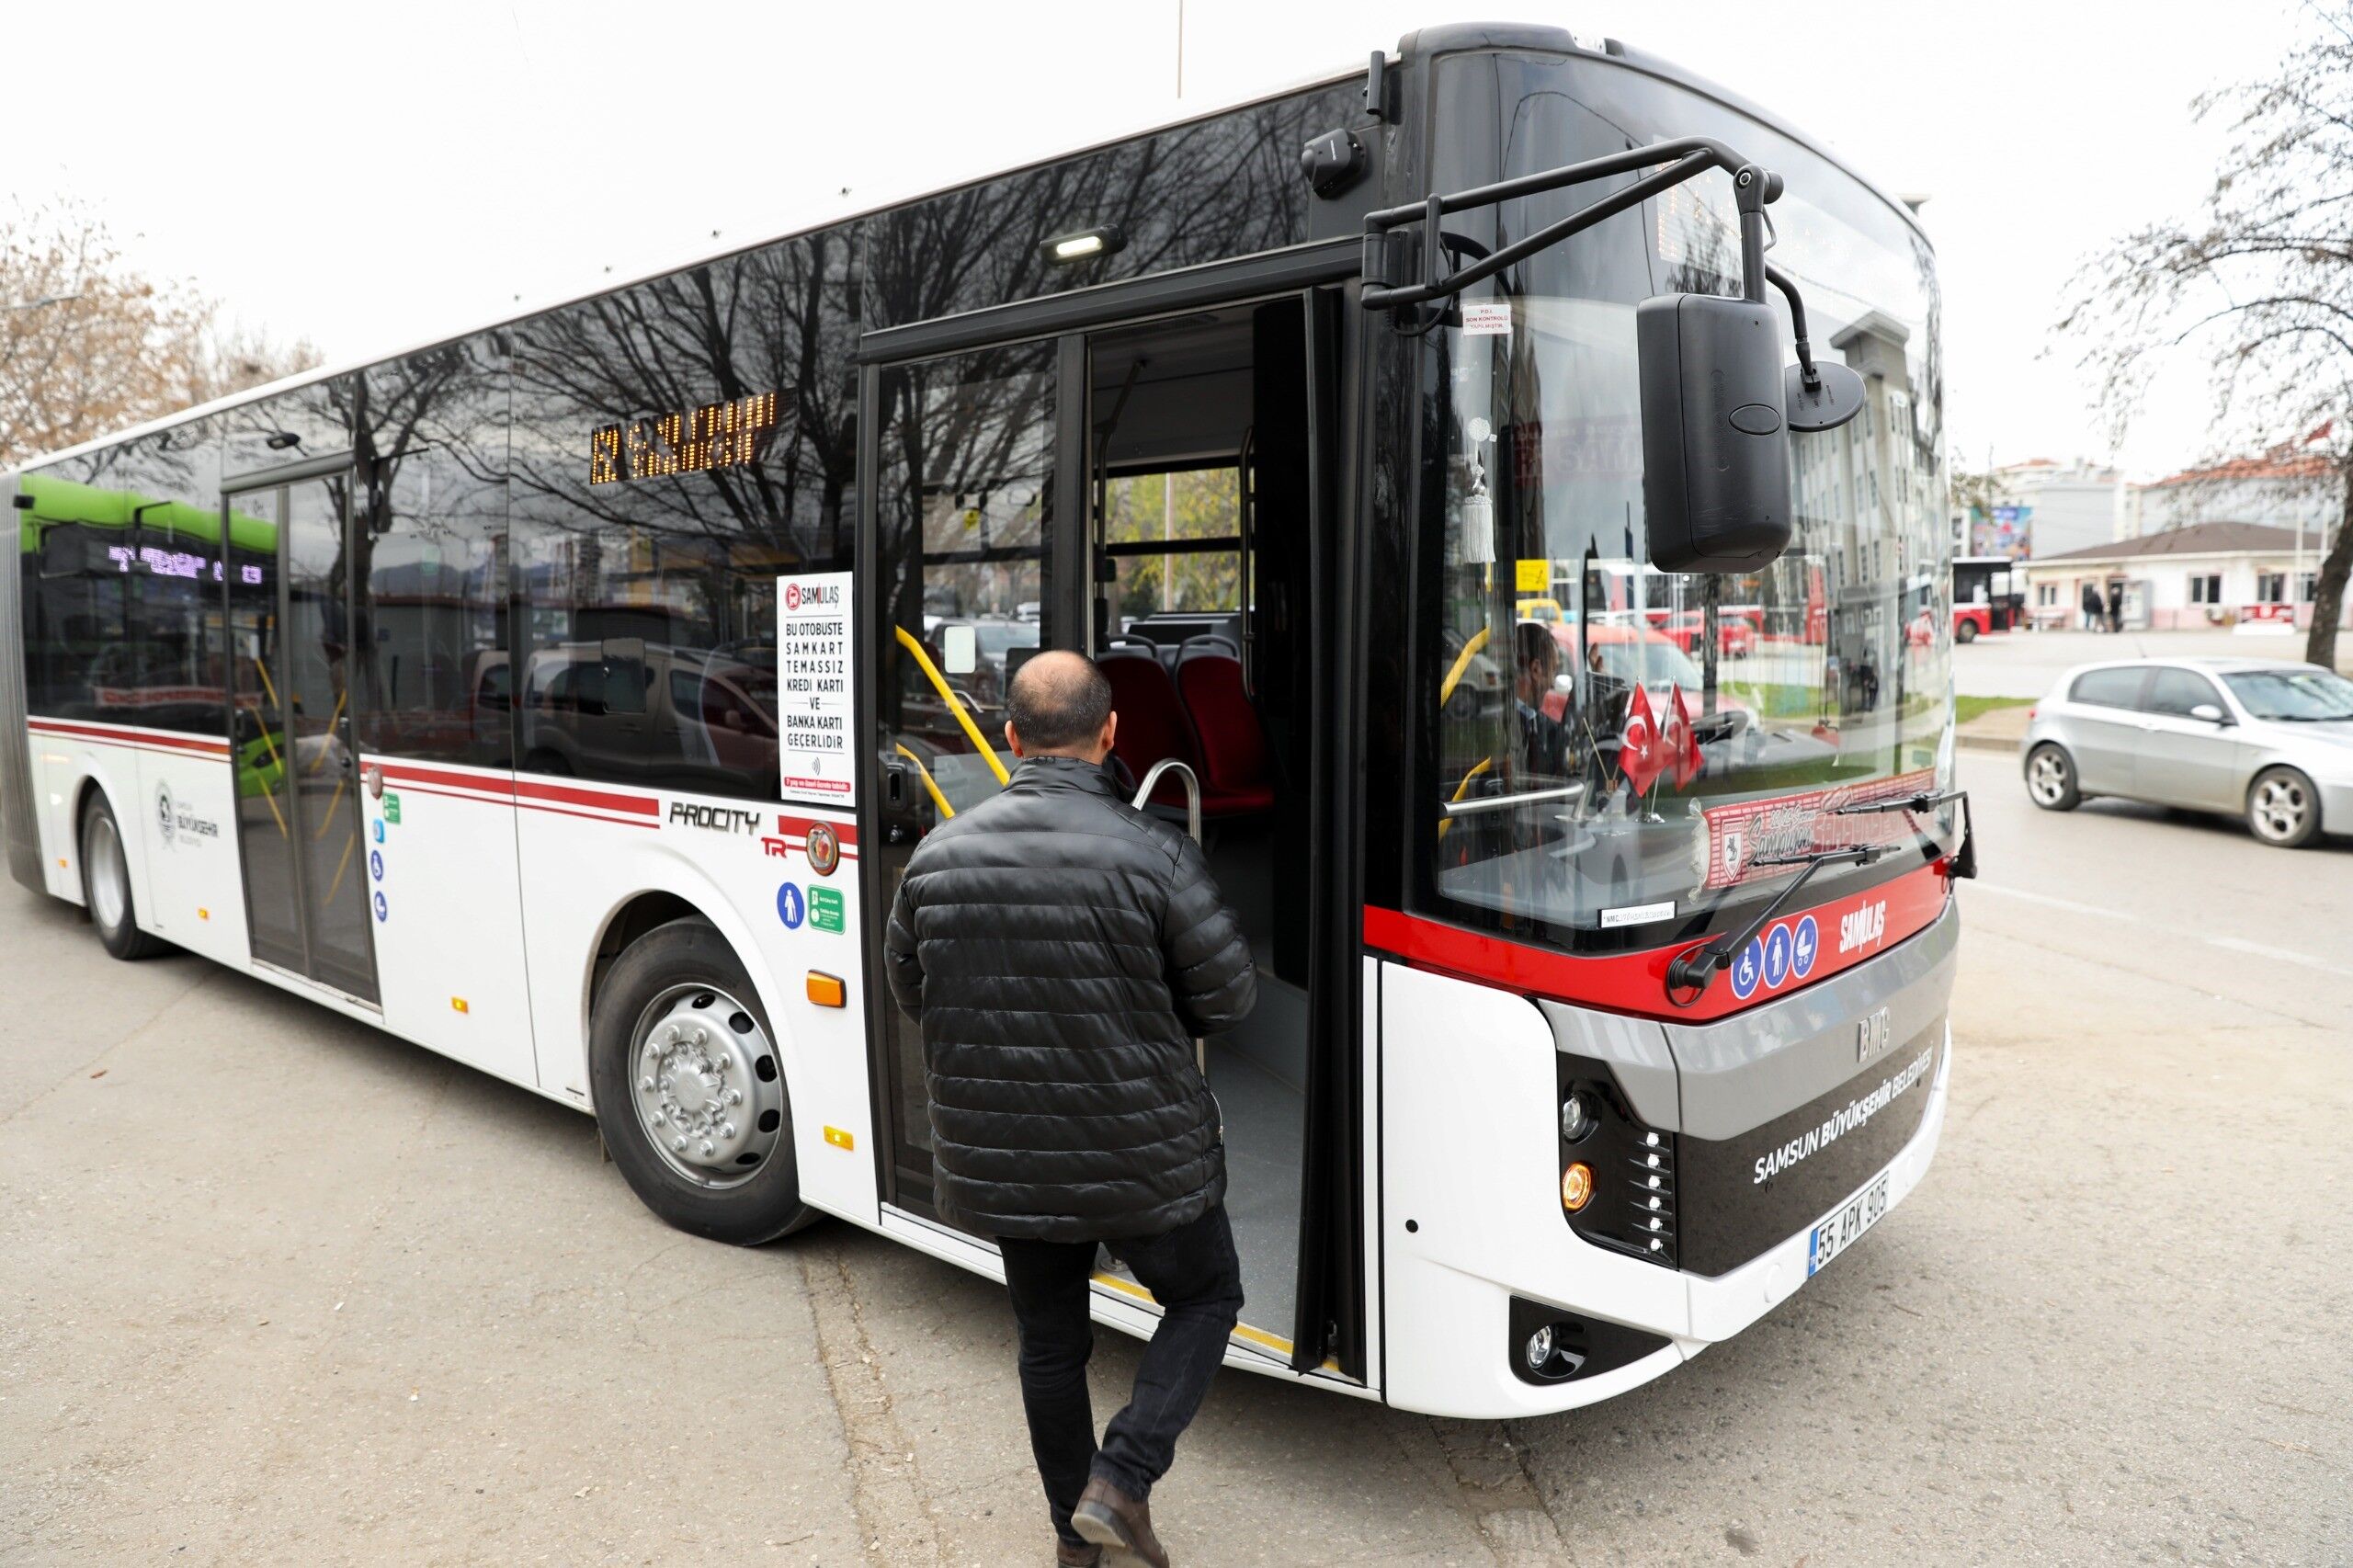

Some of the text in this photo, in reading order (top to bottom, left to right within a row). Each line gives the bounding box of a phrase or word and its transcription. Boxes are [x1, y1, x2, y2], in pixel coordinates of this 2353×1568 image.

[786, 623, 798, 636] BU
[786, 642, 844, 655] SAMKART
[786, 660, 844, 674] TEMASSIZ
[817, 678, 844, 693] KARTI
[809, 697, 821, 710] VE
[787, 714, 843, 731] BANKA KARTI
[787, 733, 844, 749] GEÇERLİDİR
[669, 801, 761, 835] PROCITY
[760, 836, 788, 858] TR
[1754, 1040, 1934, 1185] SAMSUN BÜYÜKŞEHİR BELEDİYESİ
[1817, 1178, 1887, 1265] 55 APK 905
